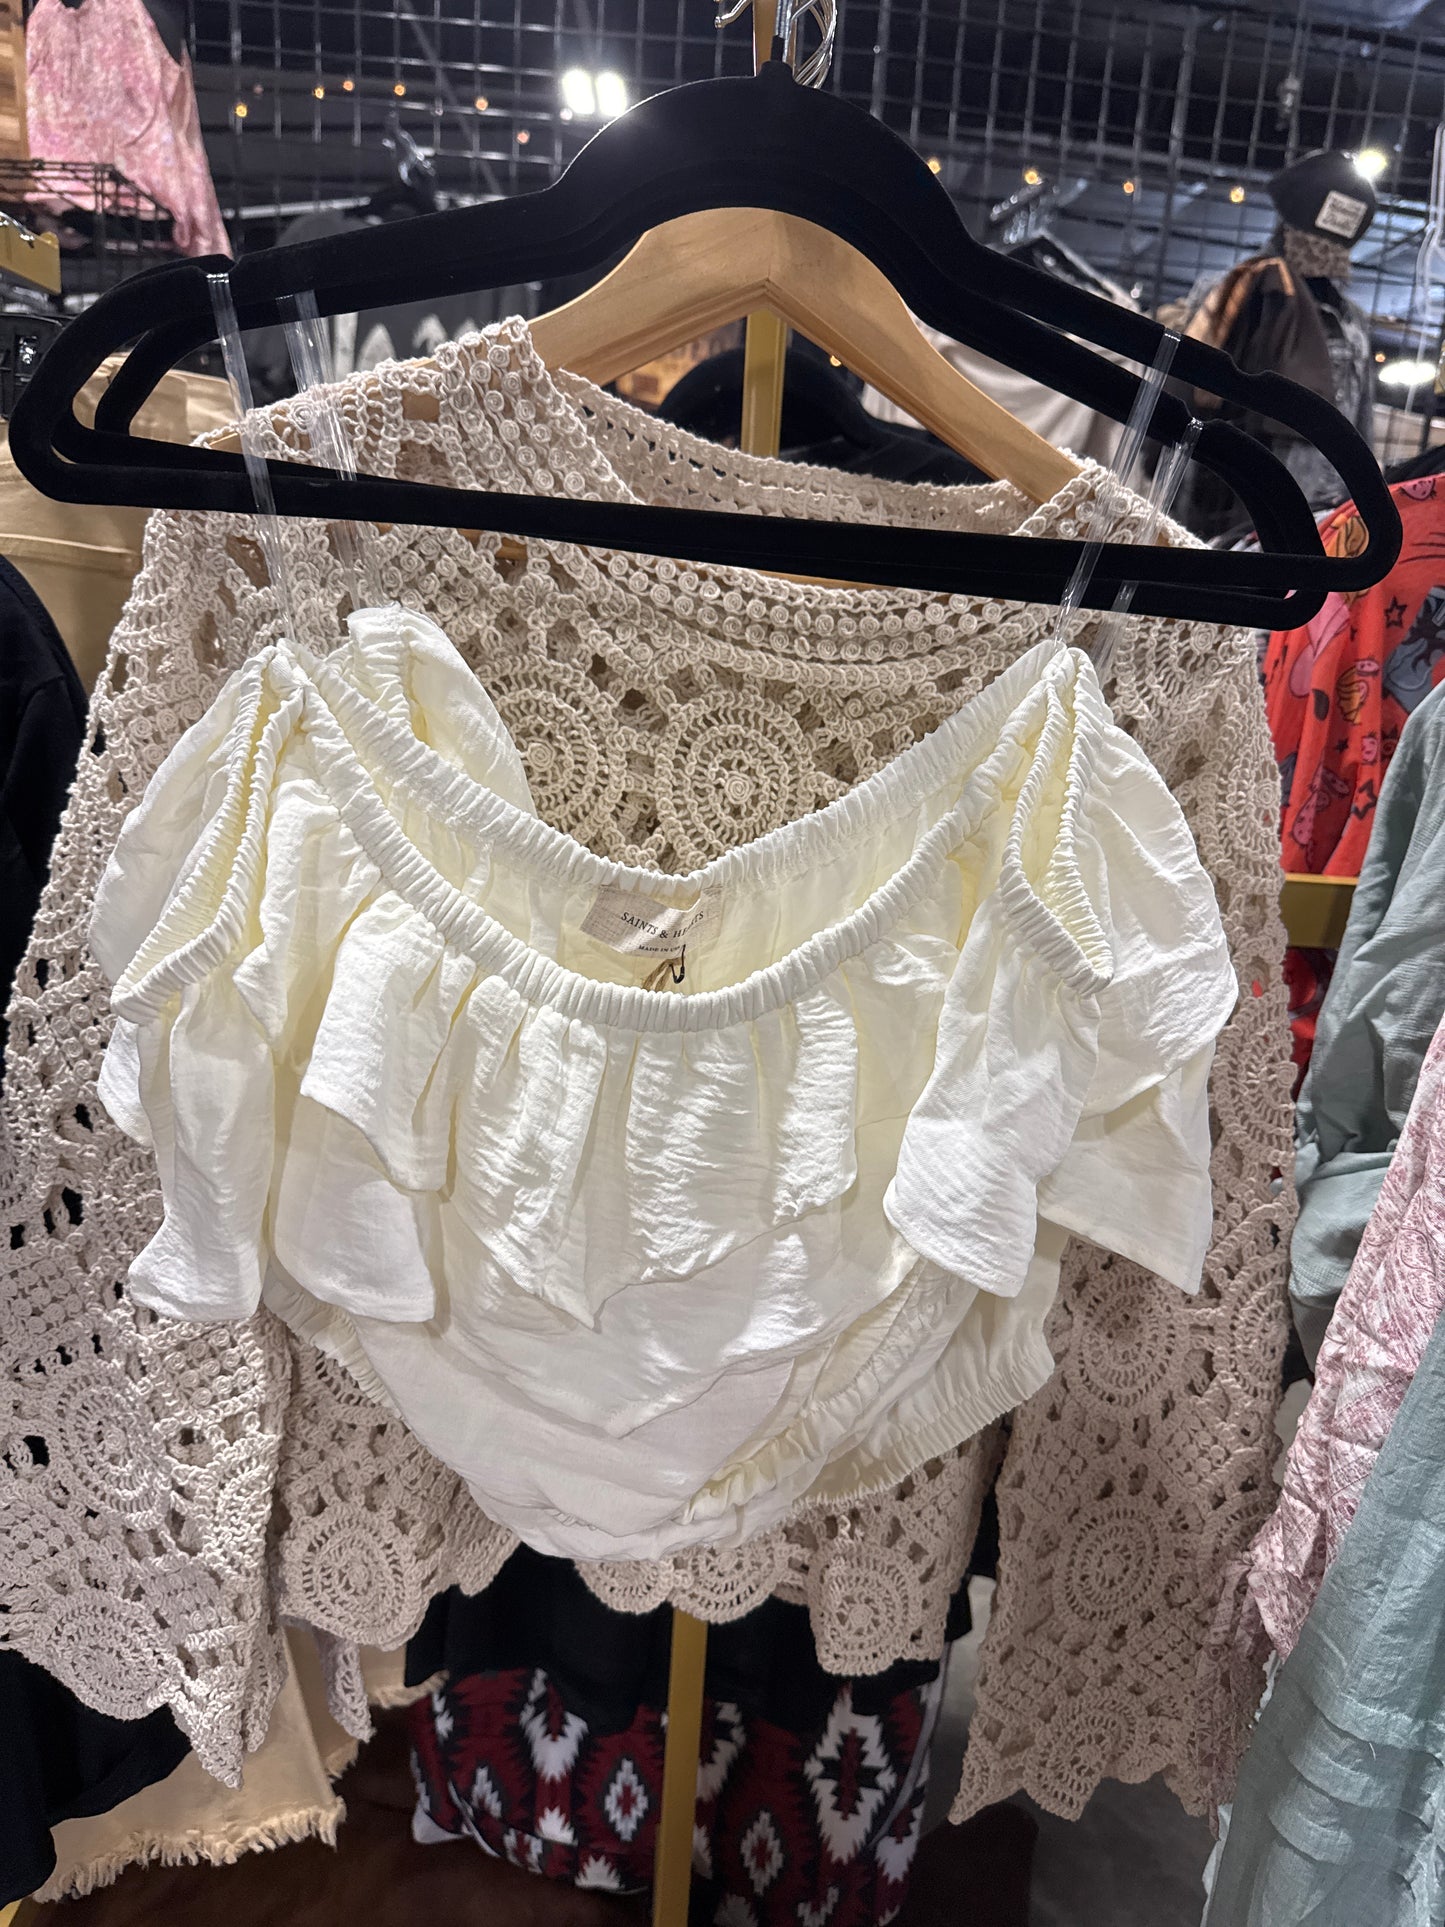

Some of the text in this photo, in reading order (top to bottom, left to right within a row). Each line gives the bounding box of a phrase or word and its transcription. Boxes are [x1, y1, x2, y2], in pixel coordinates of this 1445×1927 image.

[620, 911, 658, 935] SAINTS
[659, 930, 668, 938] &
[638, 944, 659, 952] MADE
